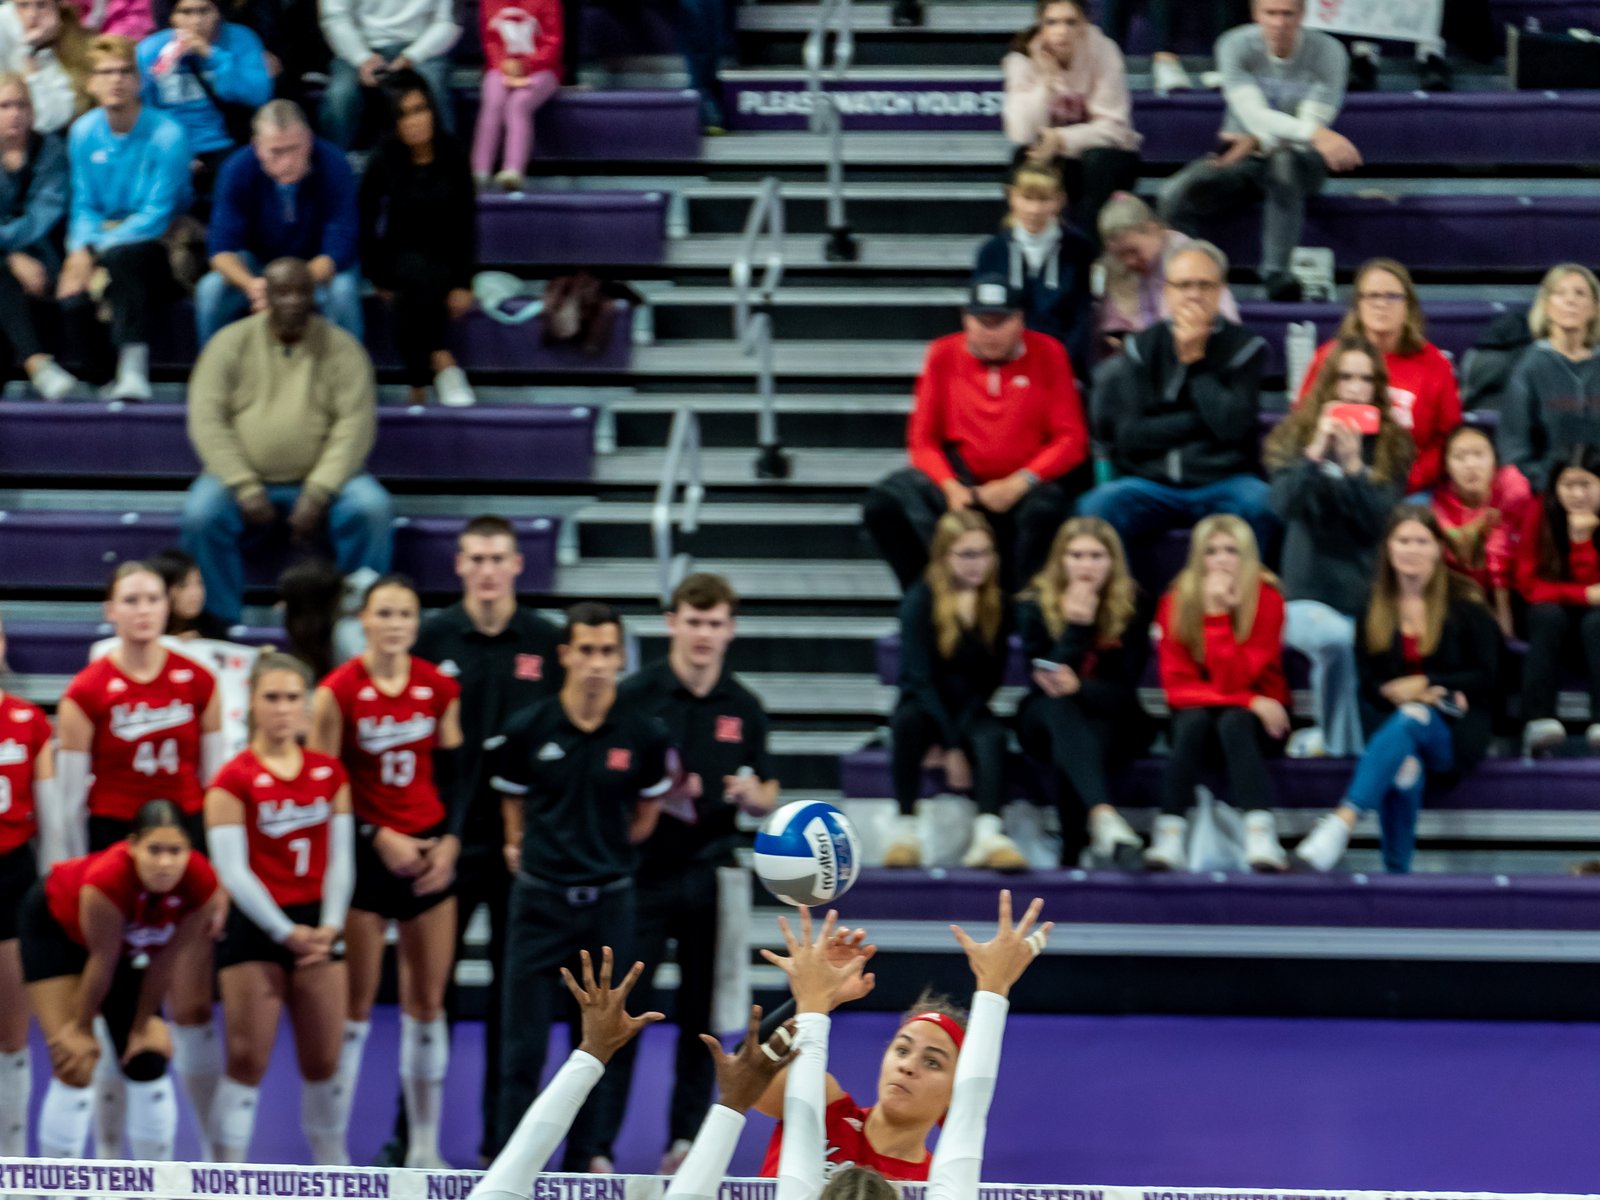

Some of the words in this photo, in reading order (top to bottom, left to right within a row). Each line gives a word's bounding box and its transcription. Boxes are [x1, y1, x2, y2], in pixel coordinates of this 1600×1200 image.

[738, 91, 822, 115] PLEAS
[916, 91, 979, 115] YOUR
[133, 737, 180, 776] 44
[380, 749, 416, 787] 13
[288, 837, 311, 877] 7
[815, 832, 834, 890] molten
[191, 1168, 390, 1199] NORTHWESTERN
